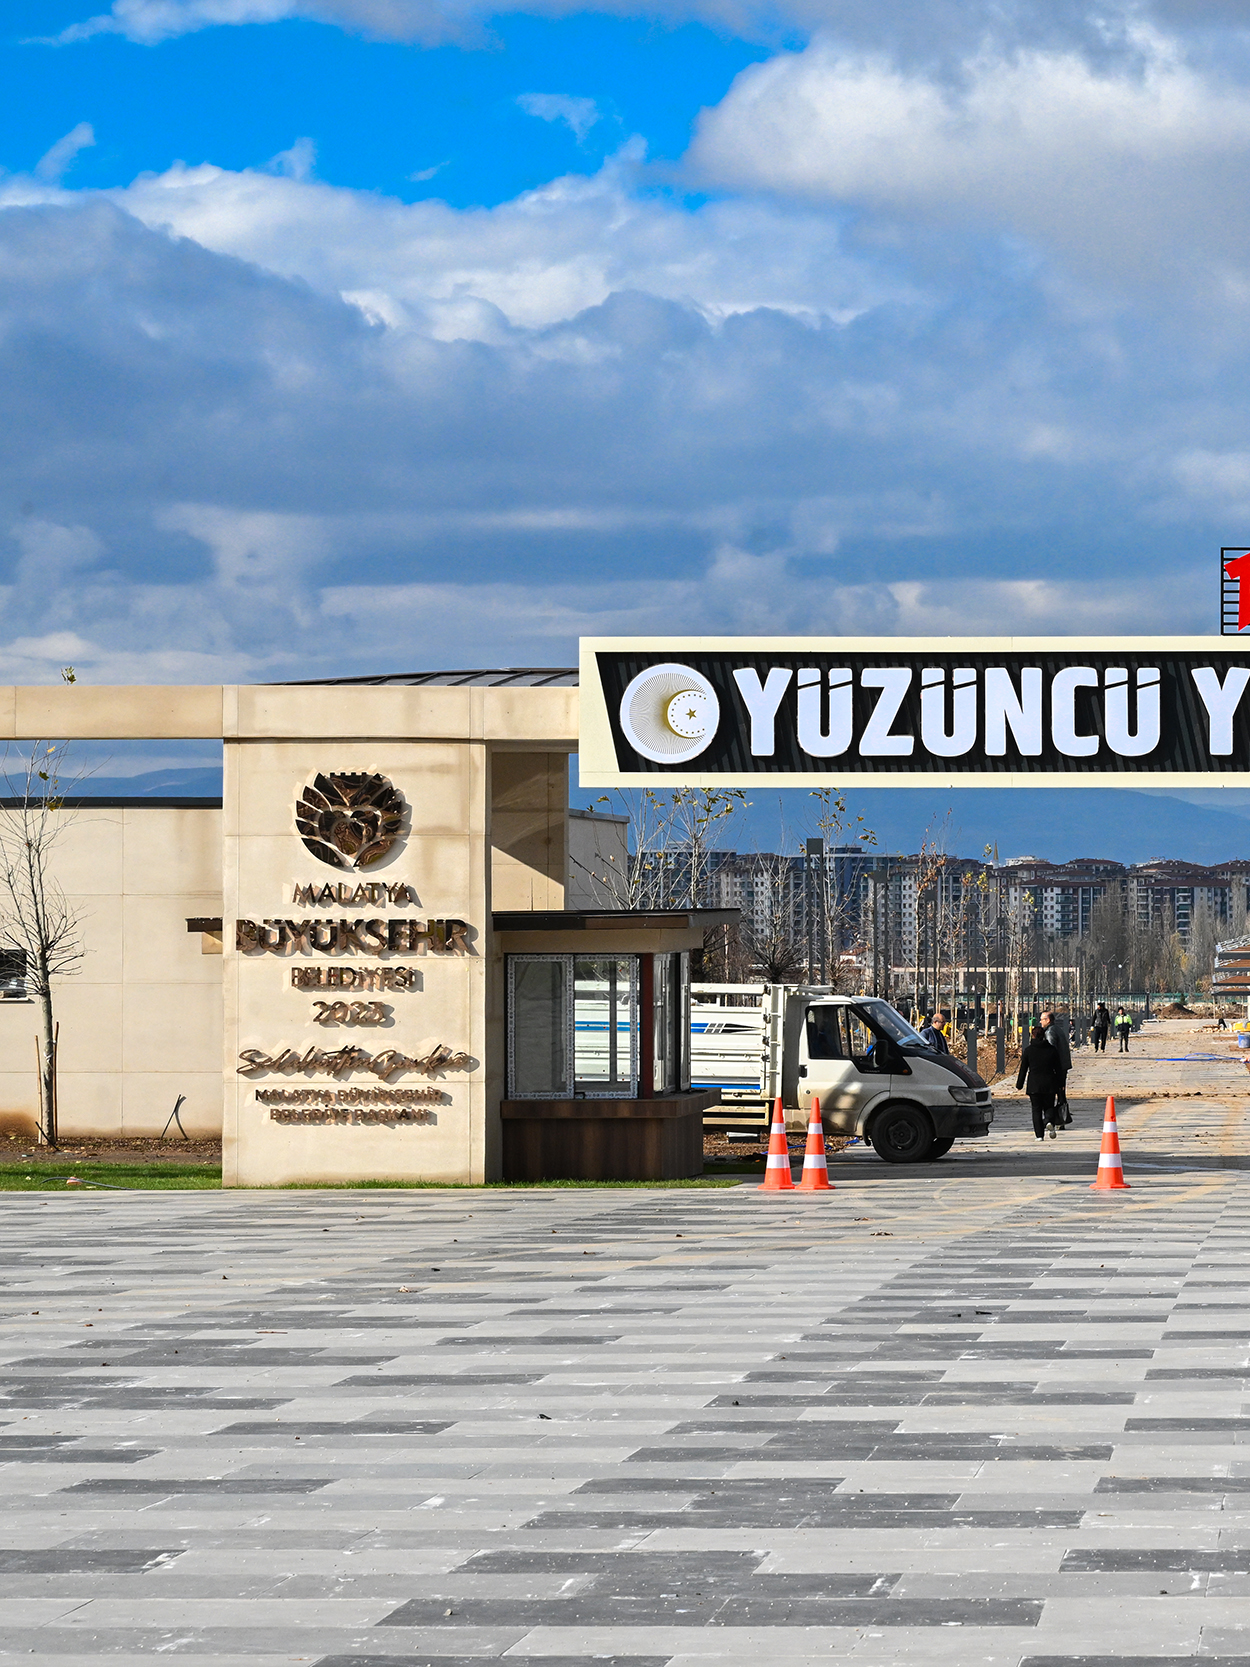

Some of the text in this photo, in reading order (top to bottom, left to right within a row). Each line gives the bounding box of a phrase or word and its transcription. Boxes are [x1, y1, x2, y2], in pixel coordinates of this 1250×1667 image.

[732, 667, 1161, 757] YÜZÜNCÜ
[292, 882, 413, 903] MALATYA
[312, 1001, 387, 1023] 2023
